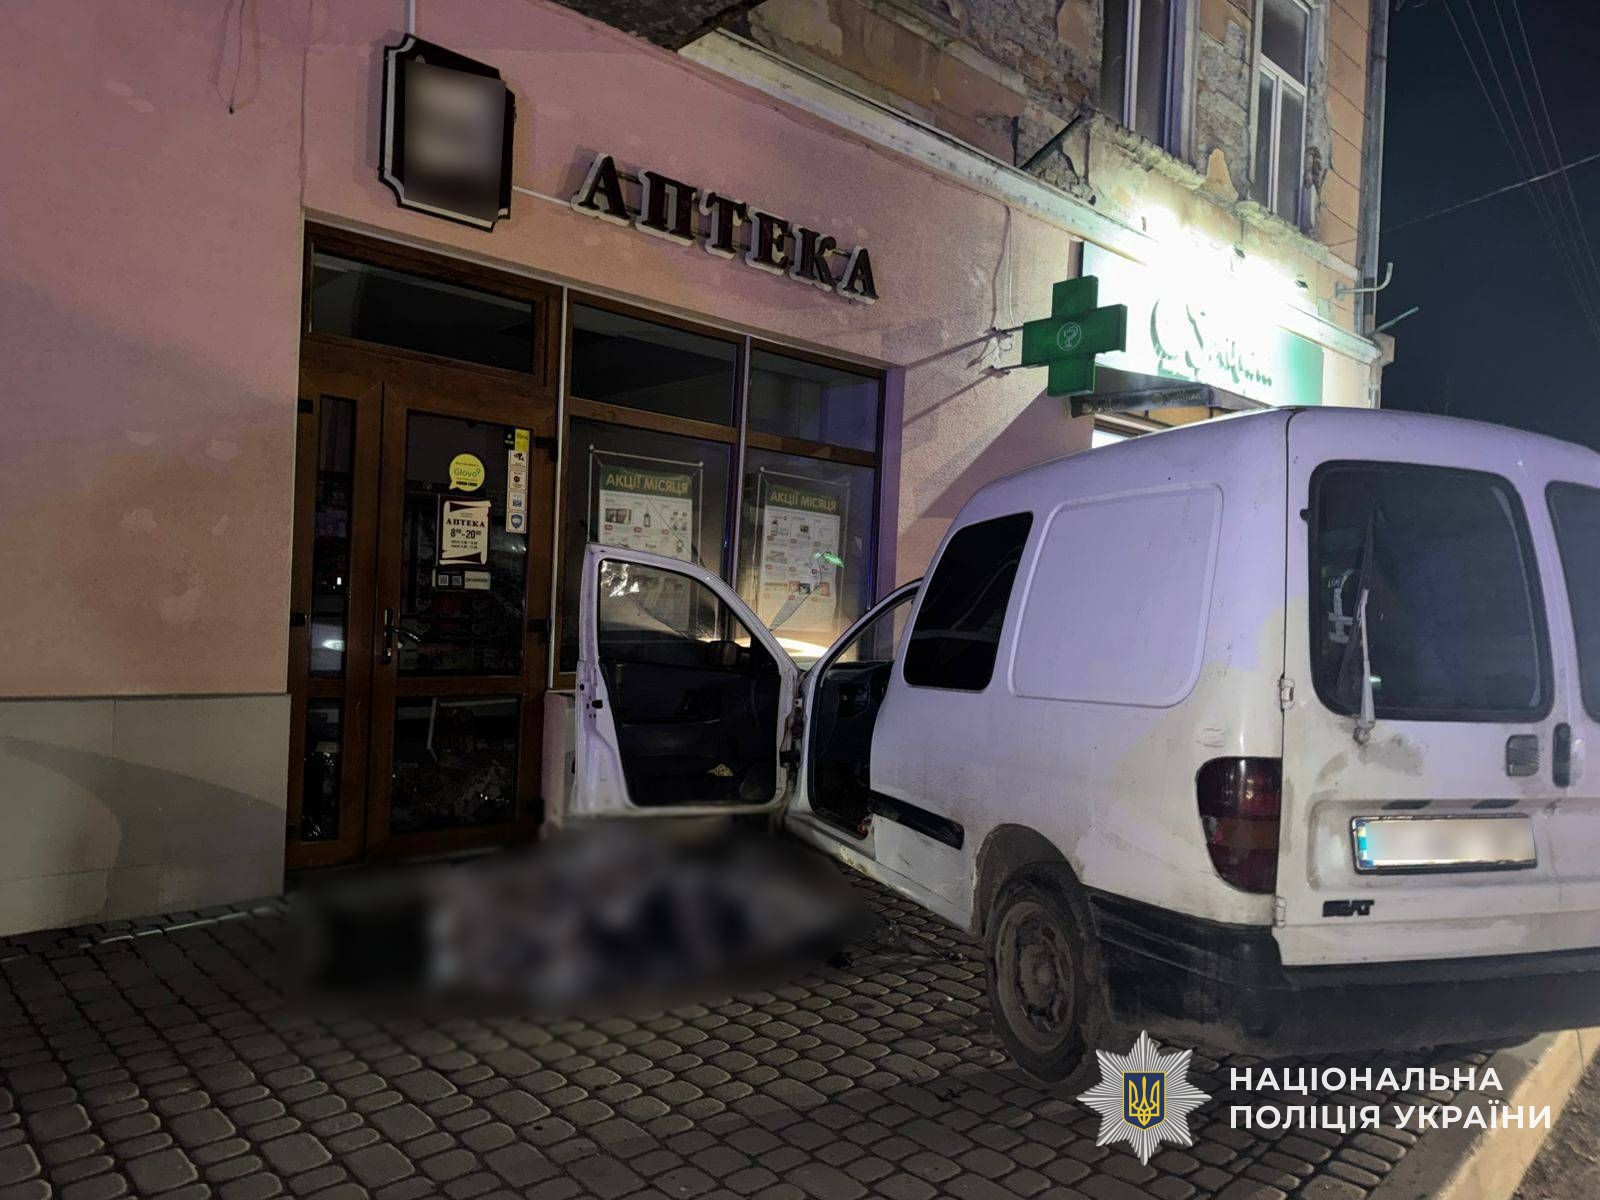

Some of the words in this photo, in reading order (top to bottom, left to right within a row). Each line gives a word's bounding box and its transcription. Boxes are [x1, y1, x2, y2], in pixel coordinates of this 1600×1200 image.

[571, 153, 879, 304] АПТЕКА
[454, 467, 480, 478] Glovo
[643, 478, 689, 496] МІСЯЦЯ
[446, 518, 485, 528] АПТЕКА
